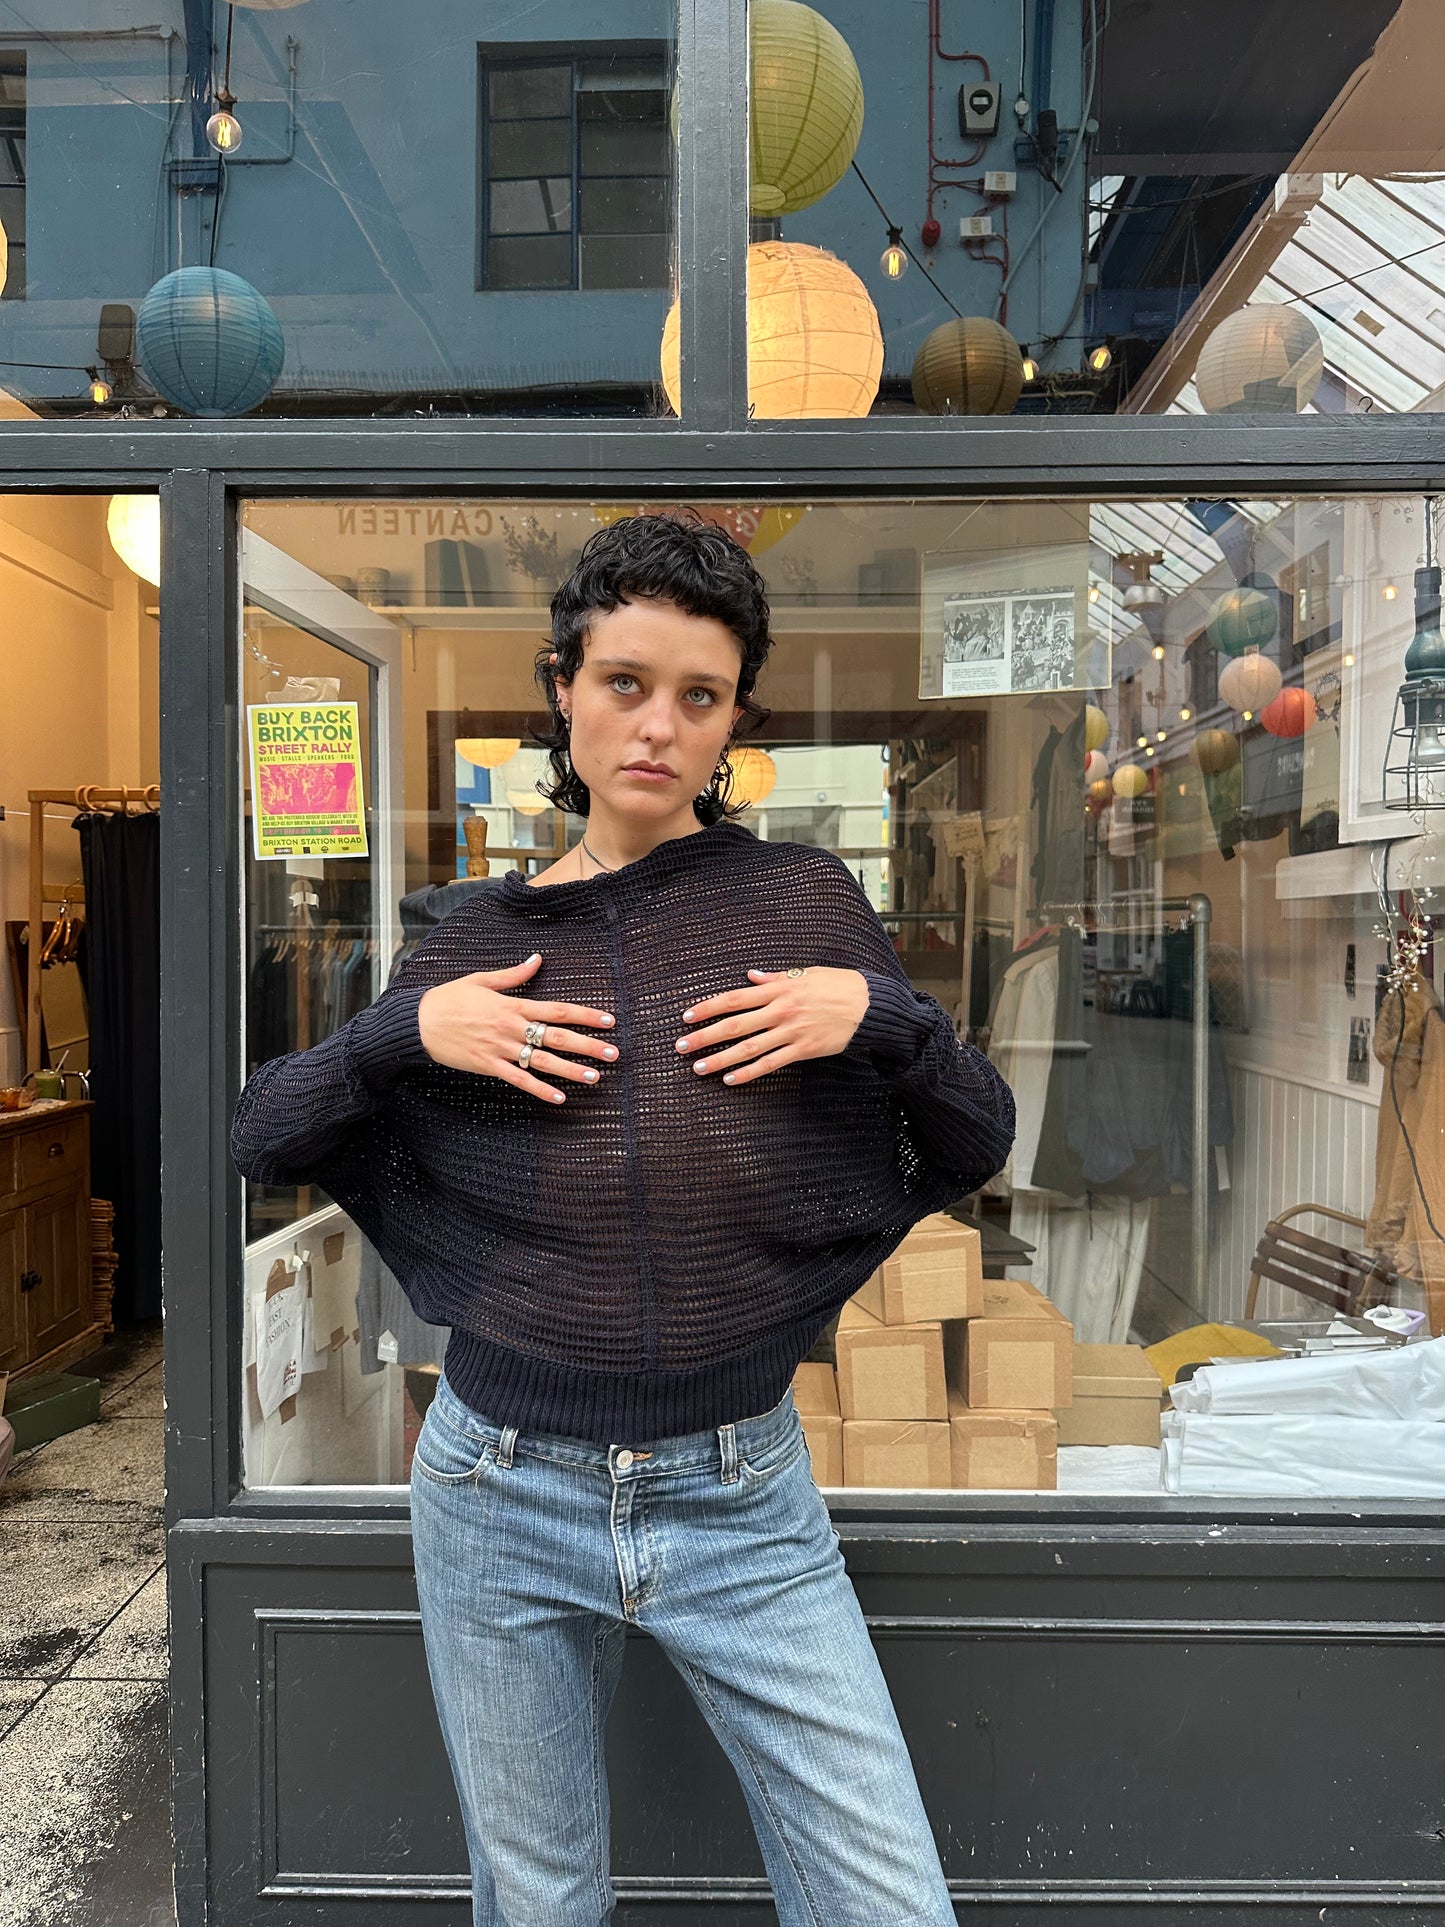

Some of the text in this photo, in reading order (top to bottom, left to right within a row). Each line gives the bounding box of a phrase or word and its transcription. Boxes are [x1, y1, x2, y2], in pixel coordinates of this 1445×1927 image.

[258, 710, 351, 725] BUY BACK
[258, 724, 353, 742] BRIXTON
[258, 742, 352, 755] STREET RALLY
[264, 828, 310, 836] SEPTEMBER
[265, 1318, 291, 1348] FASHION
